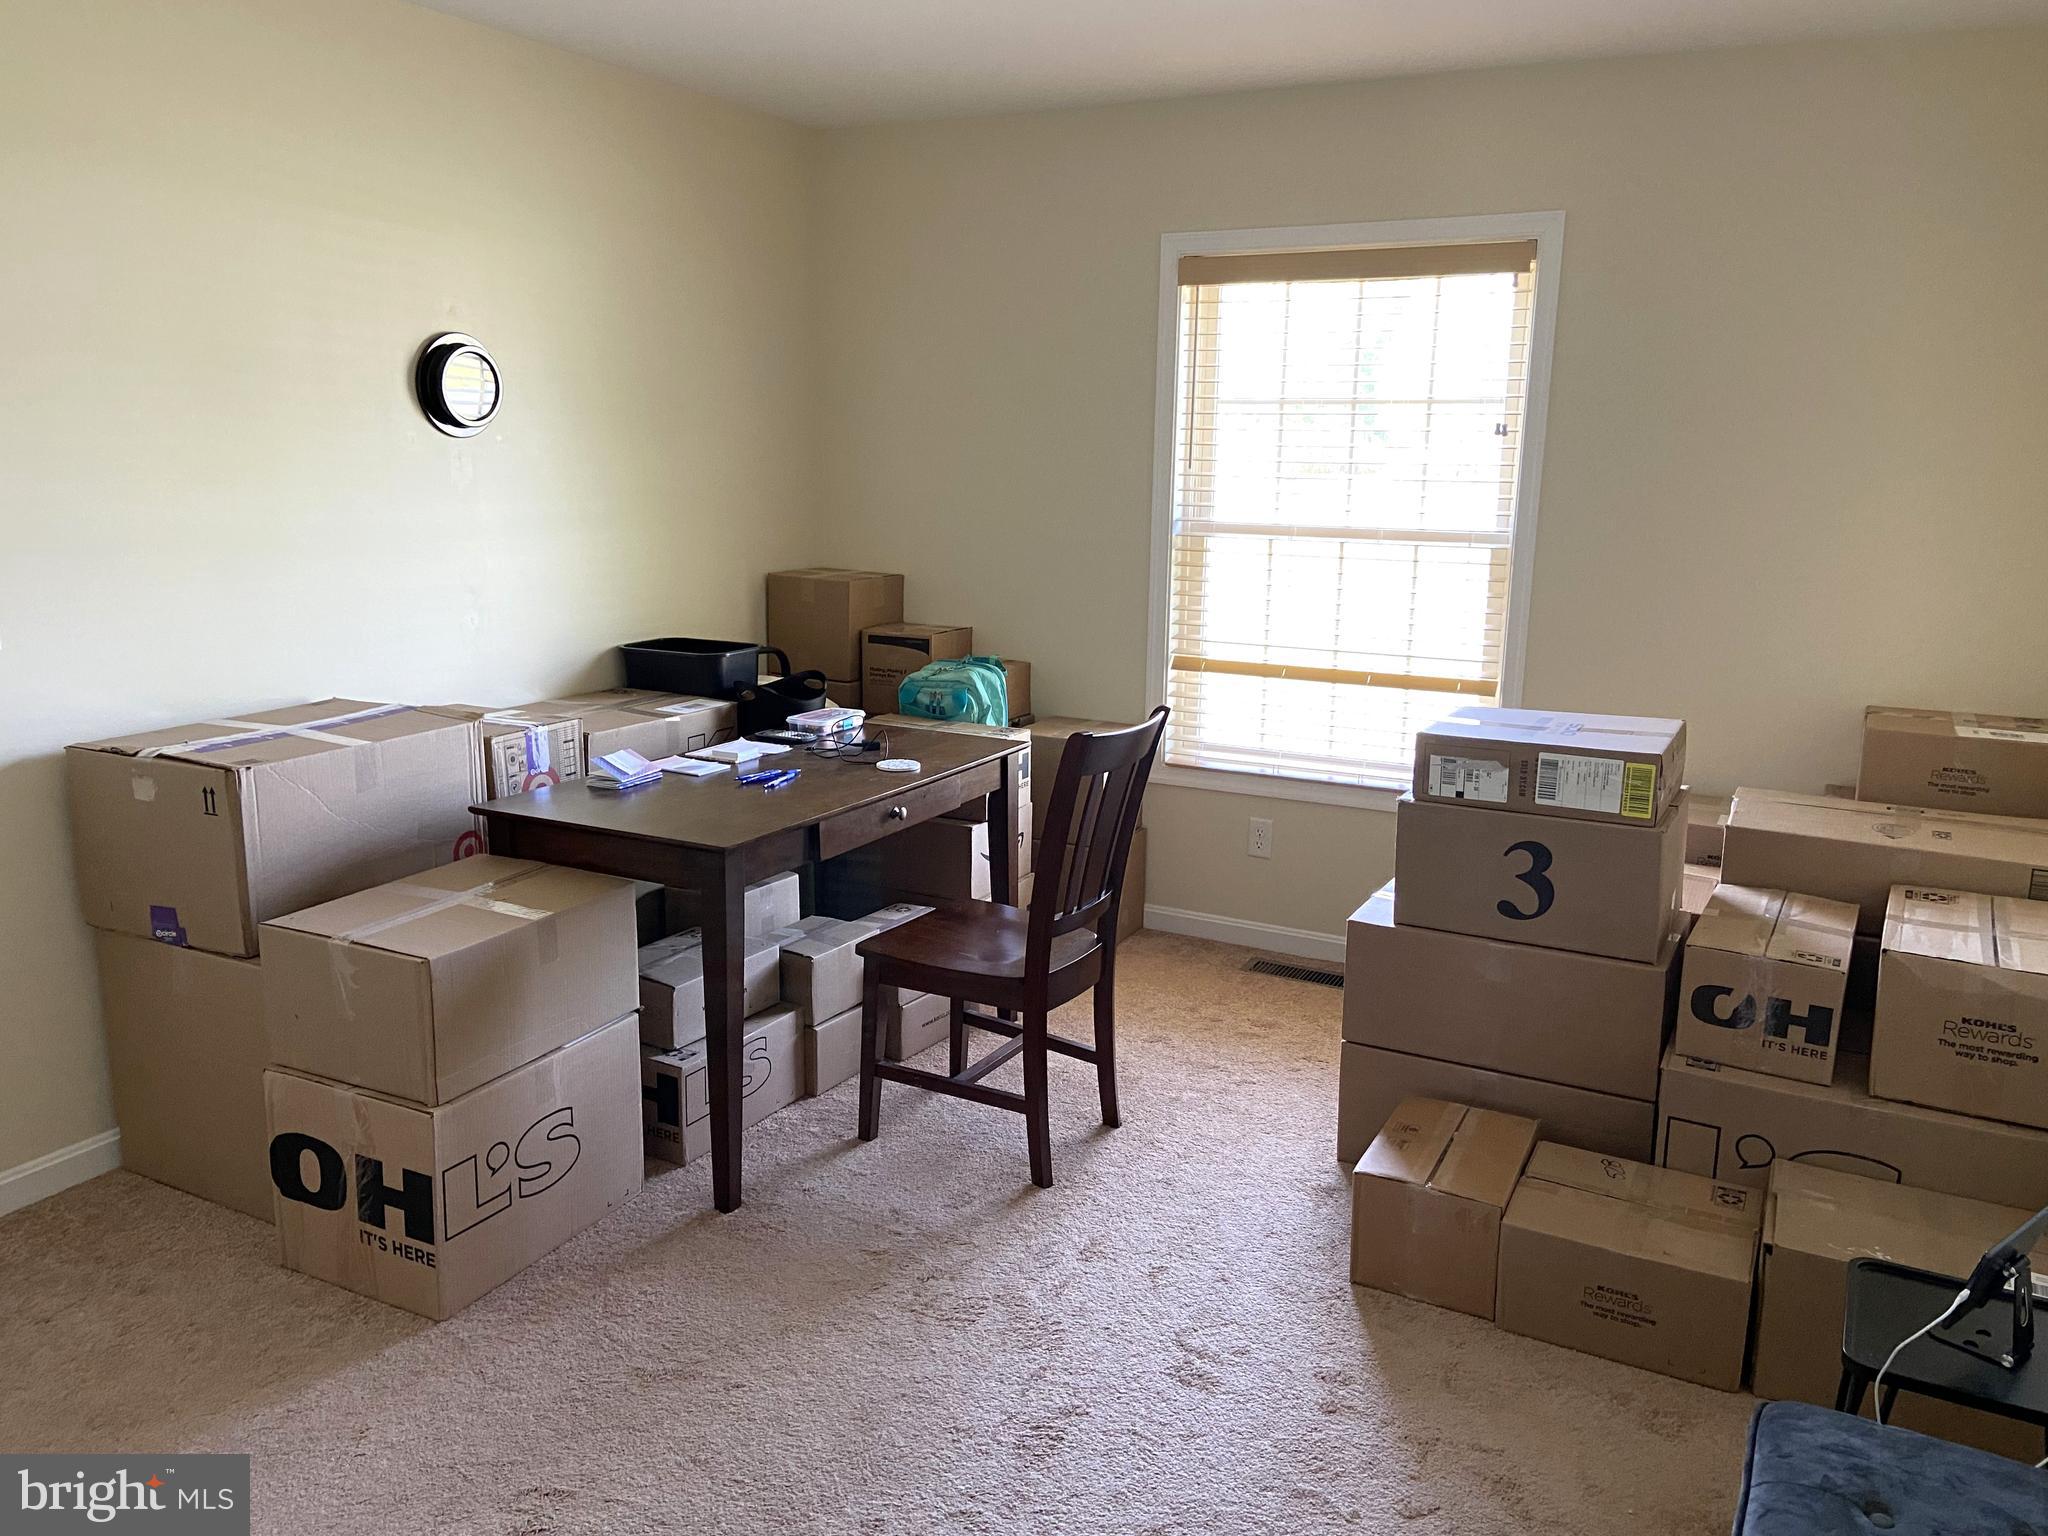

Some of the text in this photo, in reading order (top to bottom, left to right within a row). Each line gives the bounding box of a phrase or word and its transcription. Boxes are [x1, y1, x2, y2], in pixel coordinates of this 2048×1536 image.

[1497, 841, 1554, 920] 3
[1942, 1020, 2034, 1049] Rewards
[1961, 1017, 2017, 1033] KOHL'S
[1761, 1039, 1828, 1061] IT'S HERE
[1938, 1038, 2040, 1064] The most rewarding
[1955, 1051, 1976, 1060] way
[1978, 1053, 1989, 1062] to
[269, 1132, 435, 1246] OH
[359, 1229, 437, 1268] IT'S HERE
[1583, 1286, 1653, 1314] Rewards
